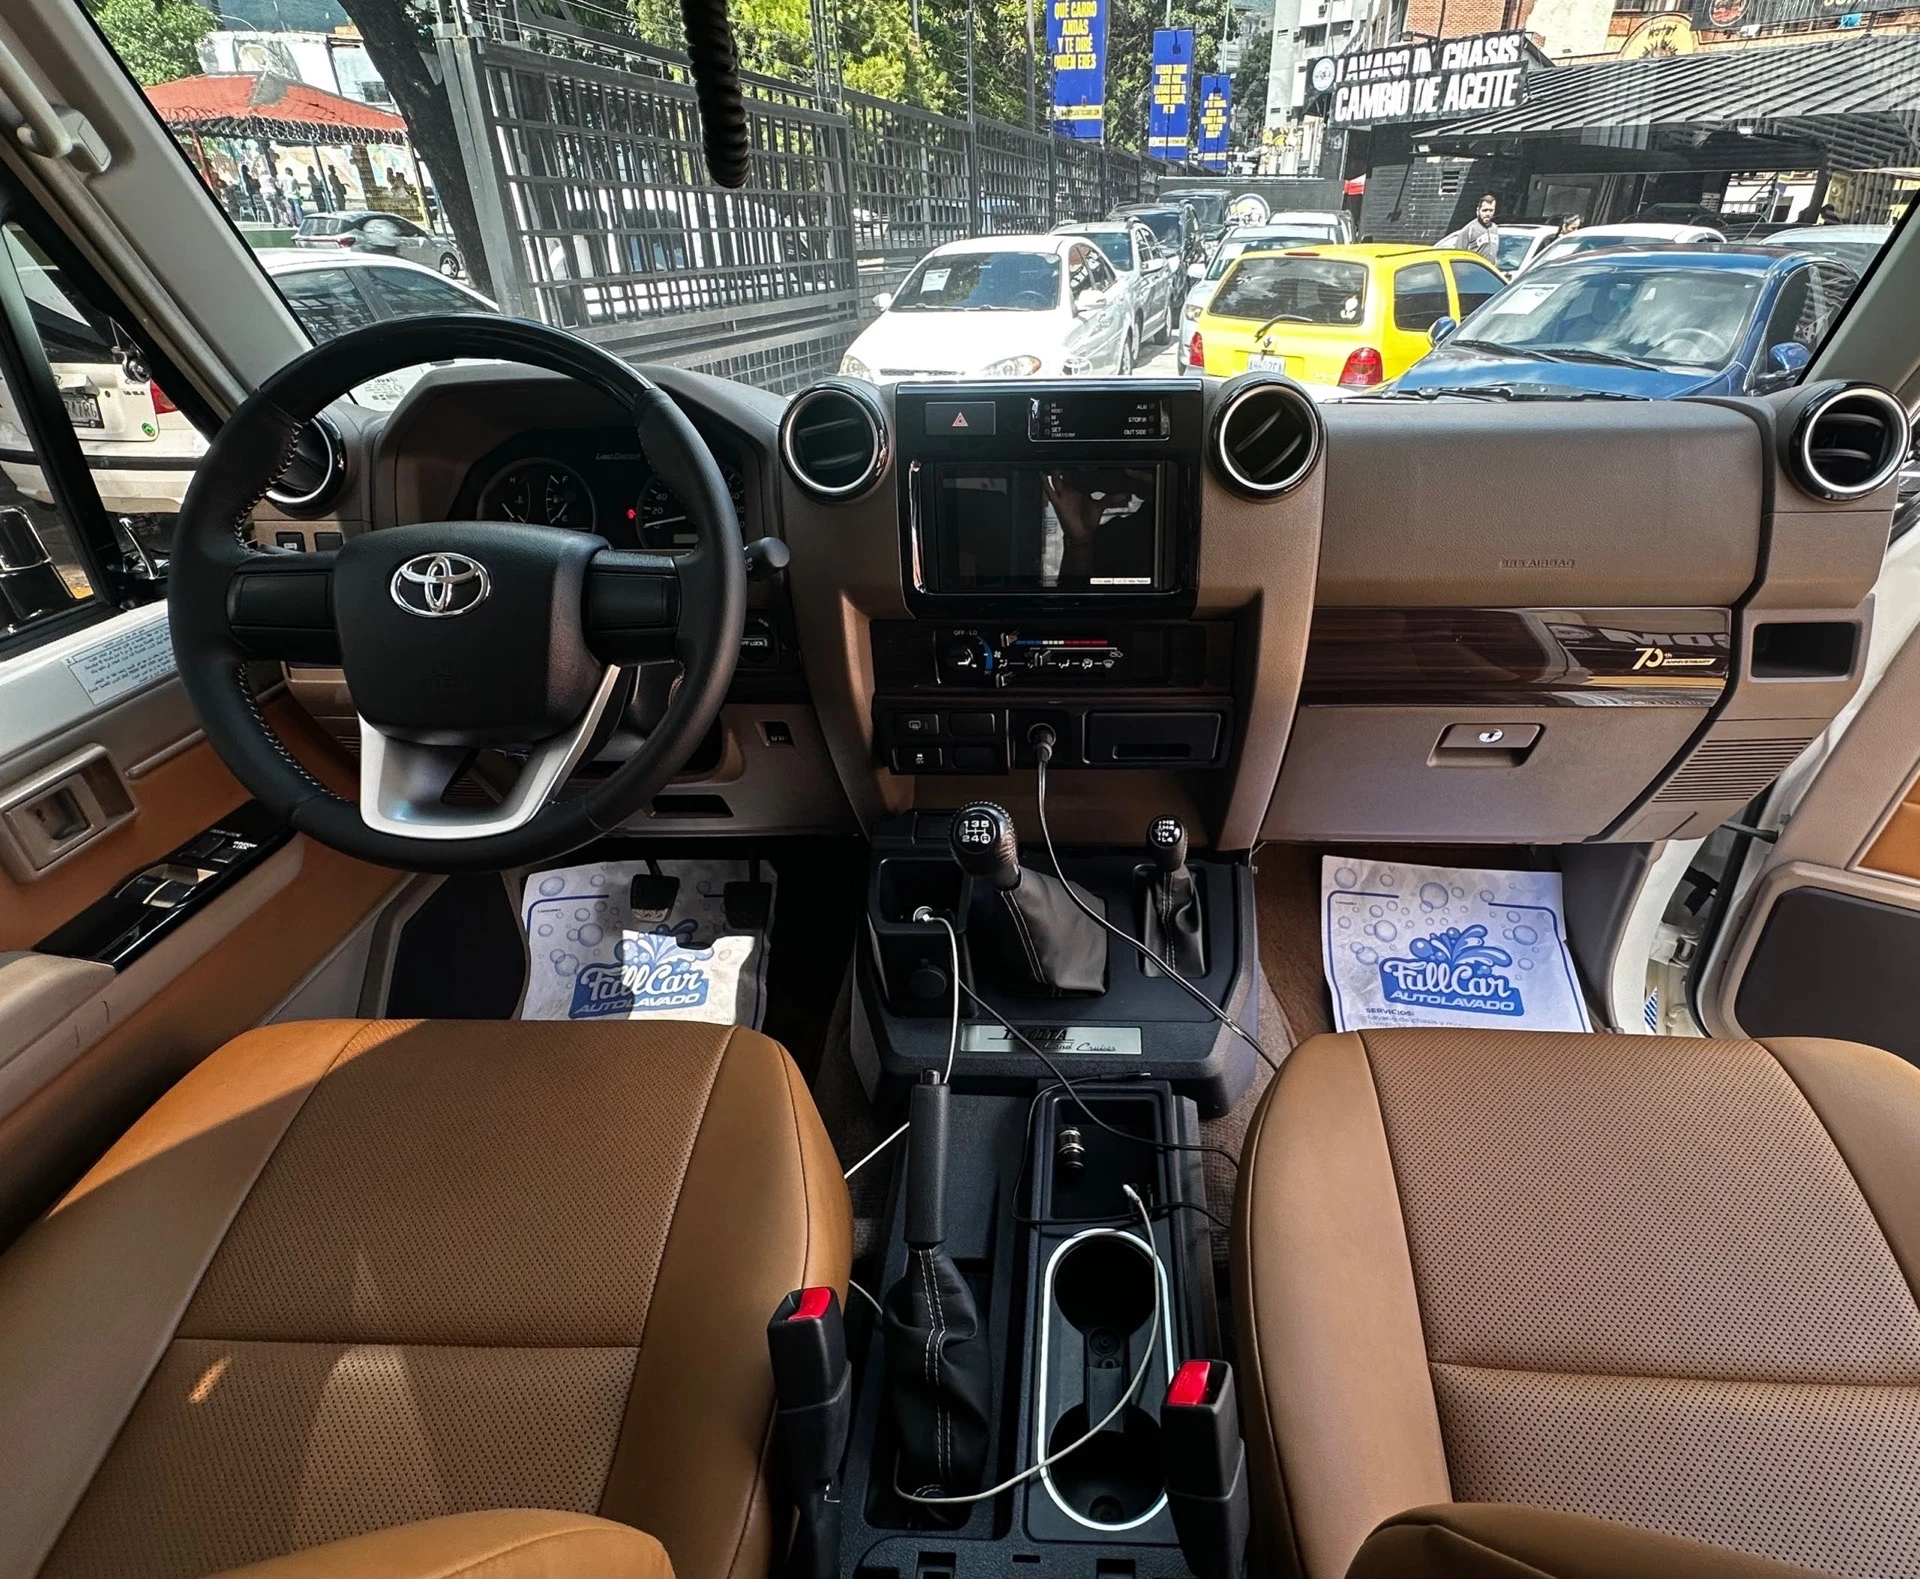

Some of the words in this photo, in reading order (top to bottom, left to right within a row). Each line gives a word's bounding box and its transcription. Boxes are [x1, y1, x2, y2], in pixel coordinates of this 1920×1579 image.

[1071, 1, 1097, 18] CARRO
[1062, 19, 1089, 36] ANDAS
[1057, 37, 1064, 53] Y
[1065, 37, 1074, 53] TE
[1441, 35, 1521, 71] CHASIS
[1078, 54, 1096, 70] ERES
[1334, 80, 1411, 122] CAMBIO
[1412, 76, 1442, 115] DE
[1443, 67, 1522, 112] ACEITE
[652, 507, 664, 515] 20
[574, 993, 700, 1014] AUTOLAVADO
[1389, 990, 1515, 1011] AUTOLAVADO
